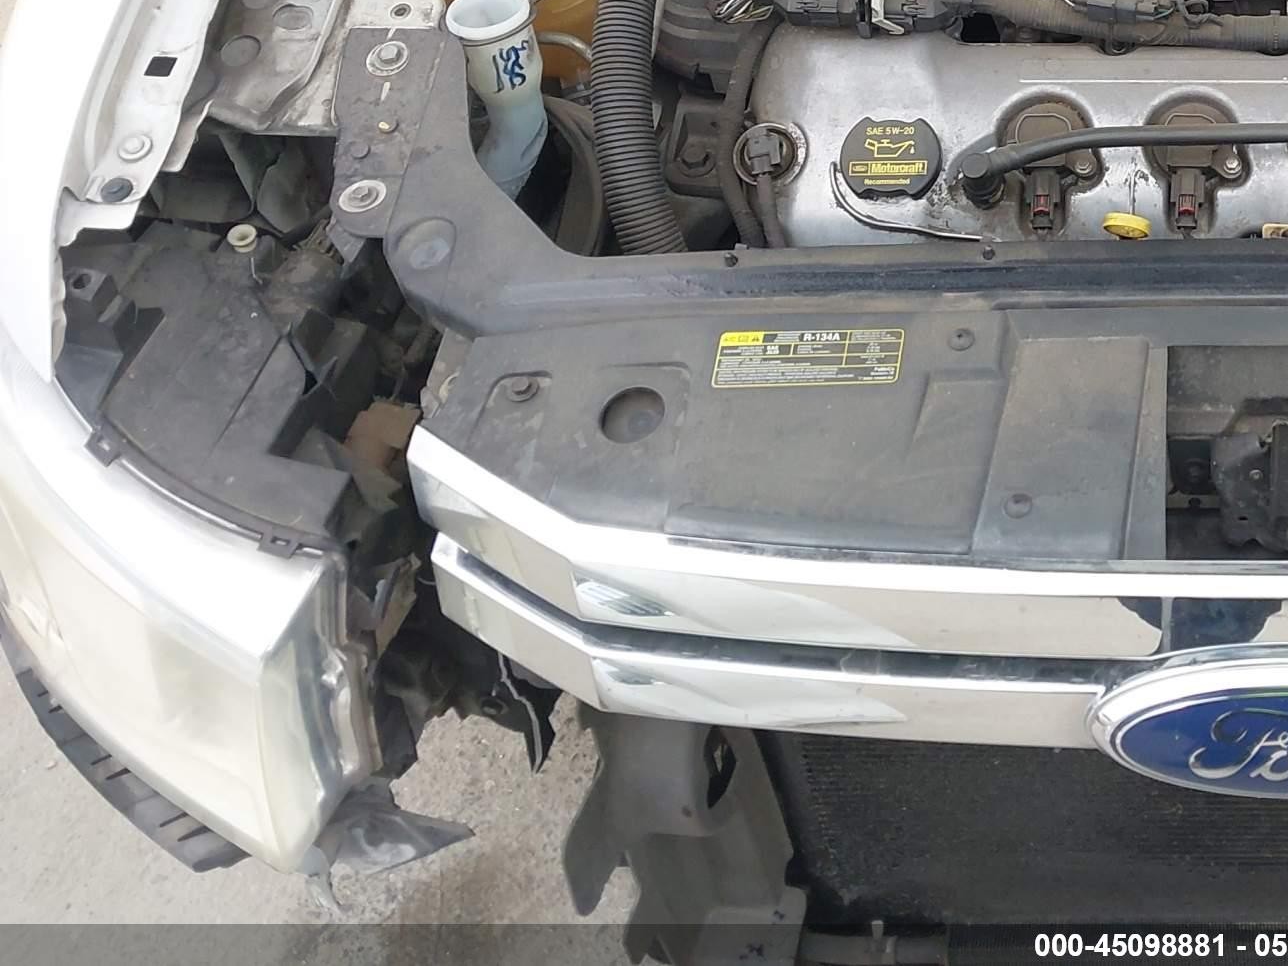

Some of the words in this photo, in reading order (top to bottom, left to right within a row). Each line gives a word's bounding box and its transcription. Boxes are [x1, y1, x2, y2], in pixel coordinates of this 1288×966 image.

[866, 126, 884, 135] SAE
[885, 126, 915, 135] 5W-20
[871, 162, 925, 173] Motorcraft
[803, 332, 841, 341] R-134A
